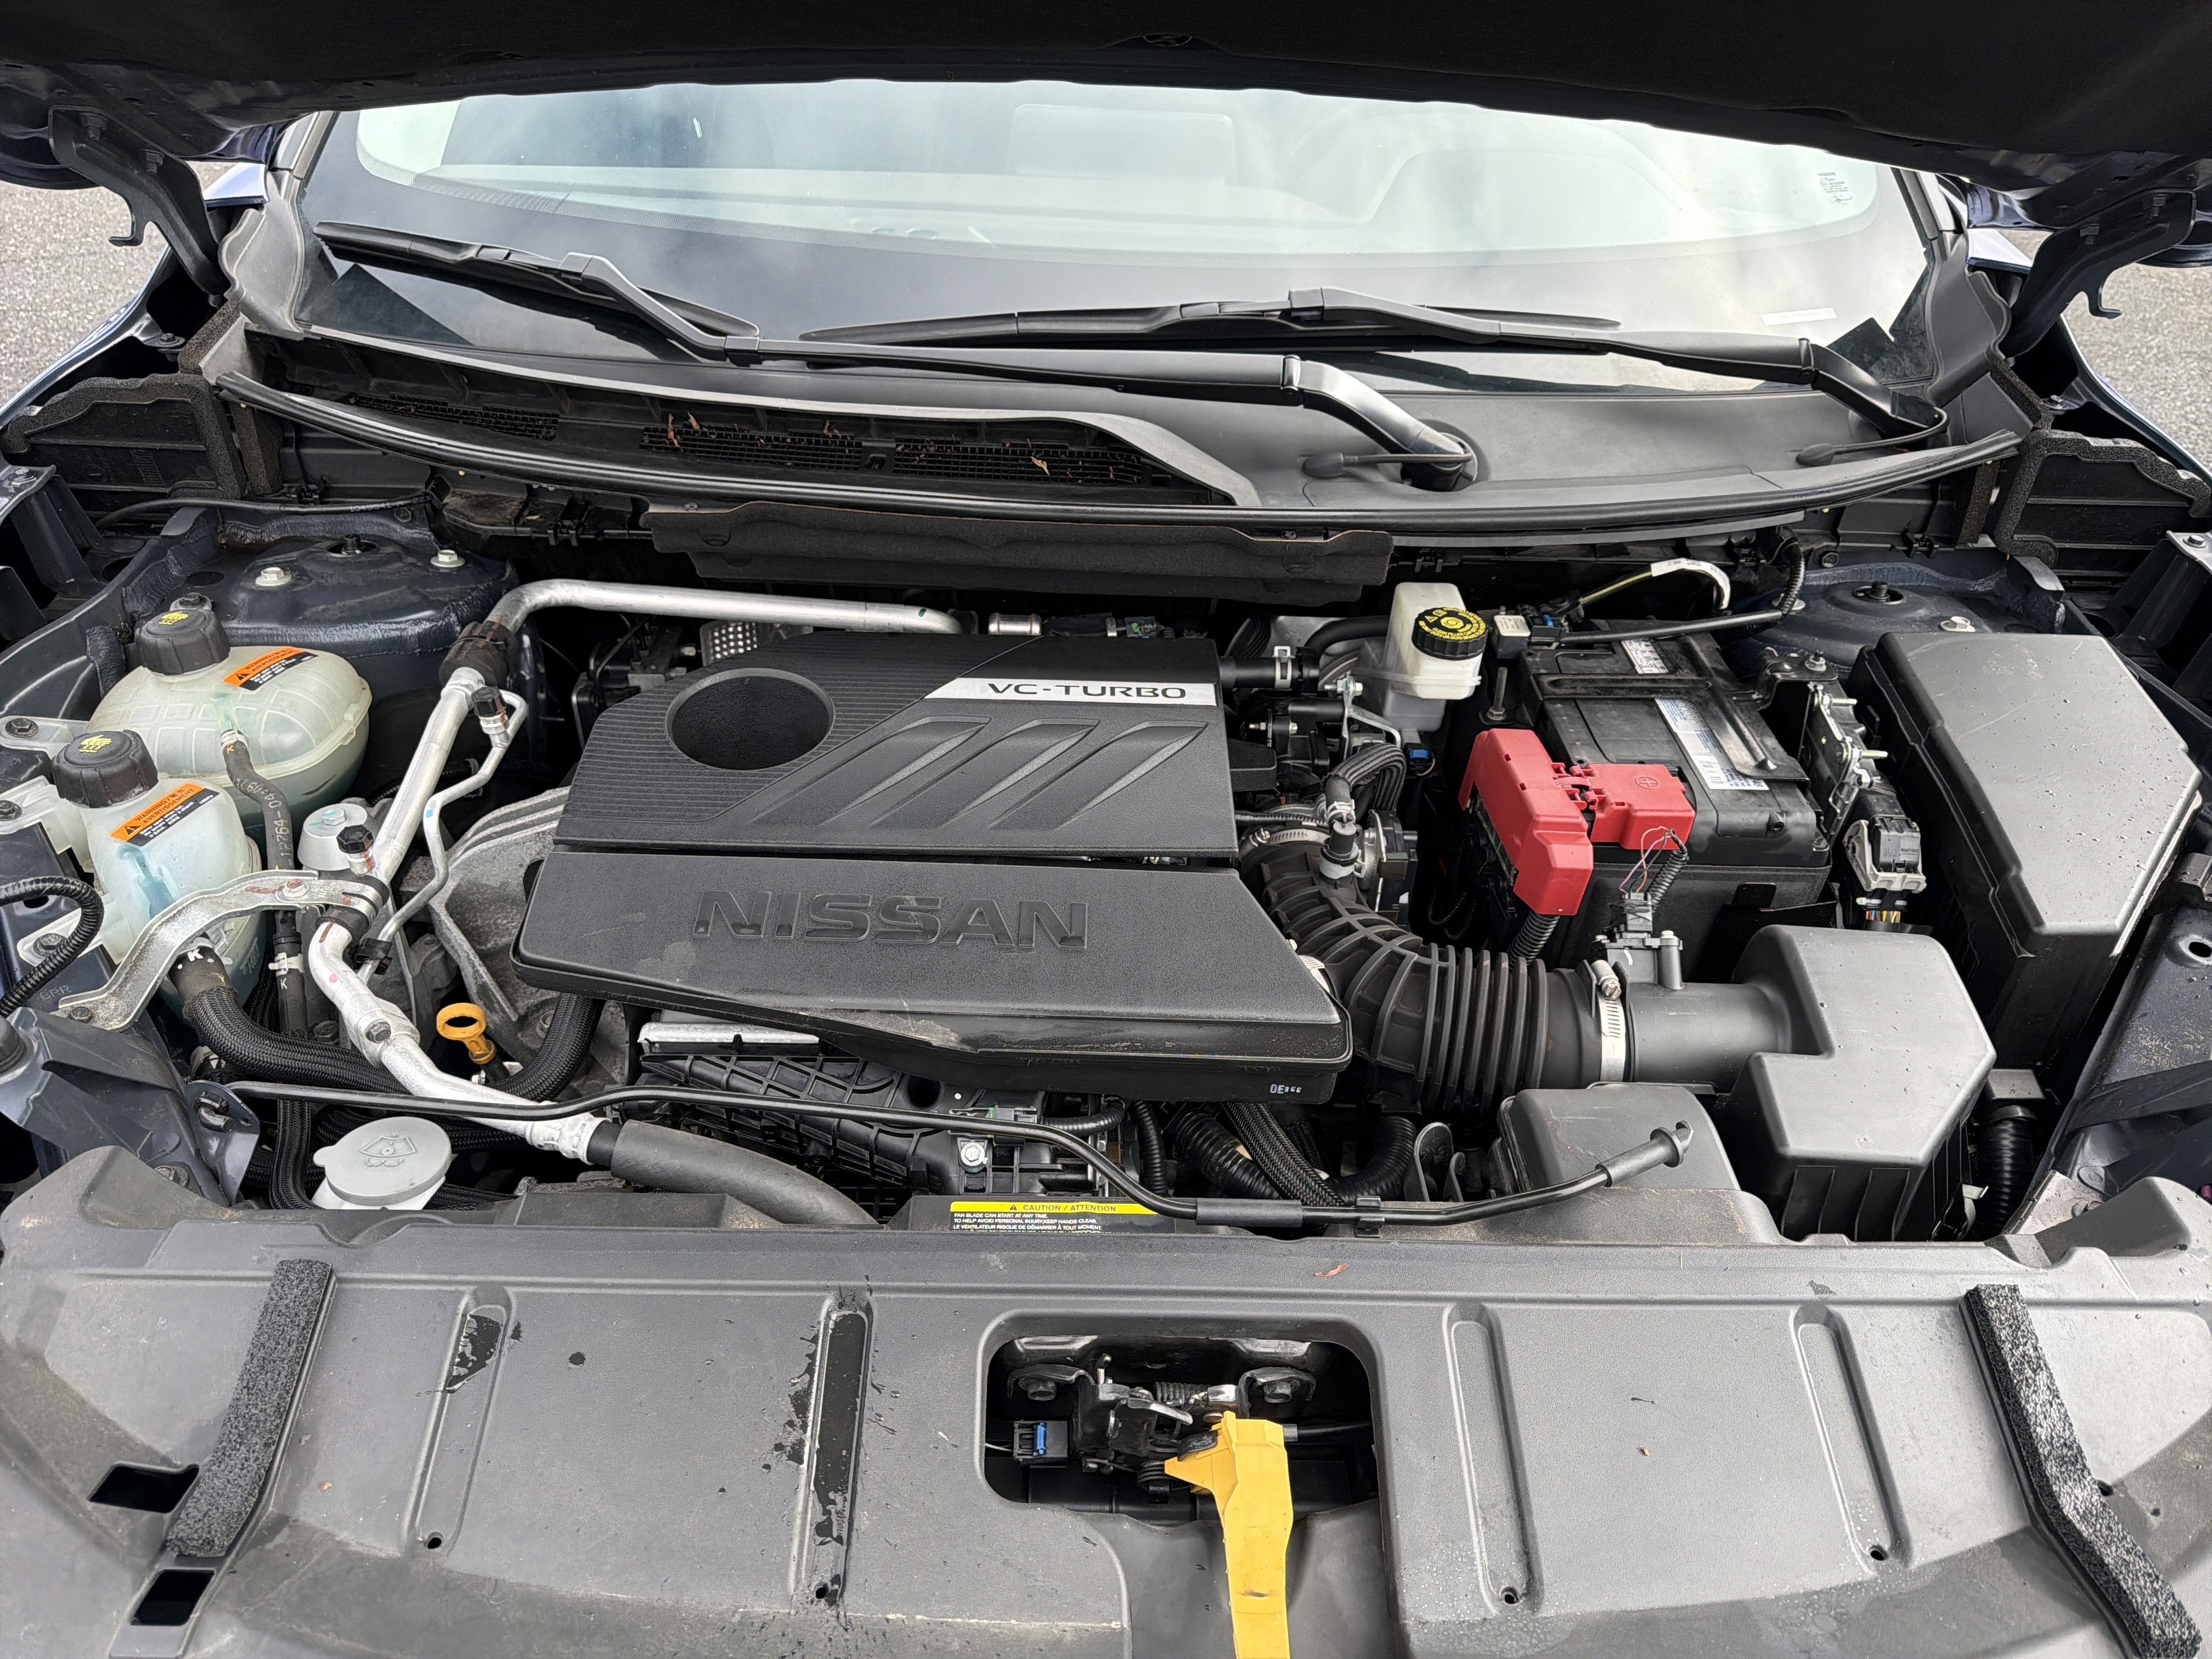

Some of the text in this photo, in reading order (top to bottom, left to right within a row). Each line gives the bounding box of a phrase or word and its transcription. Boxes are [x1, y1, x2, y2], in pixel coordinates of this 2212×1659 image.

[988, 683, 1187, 699] VC-TURBO
[135, 800, 167, 822] WARNING
[692, 890, 1088, 950] NISSAN
[187, 948, 204, 962] K
[280, 978, 288, 990] K
